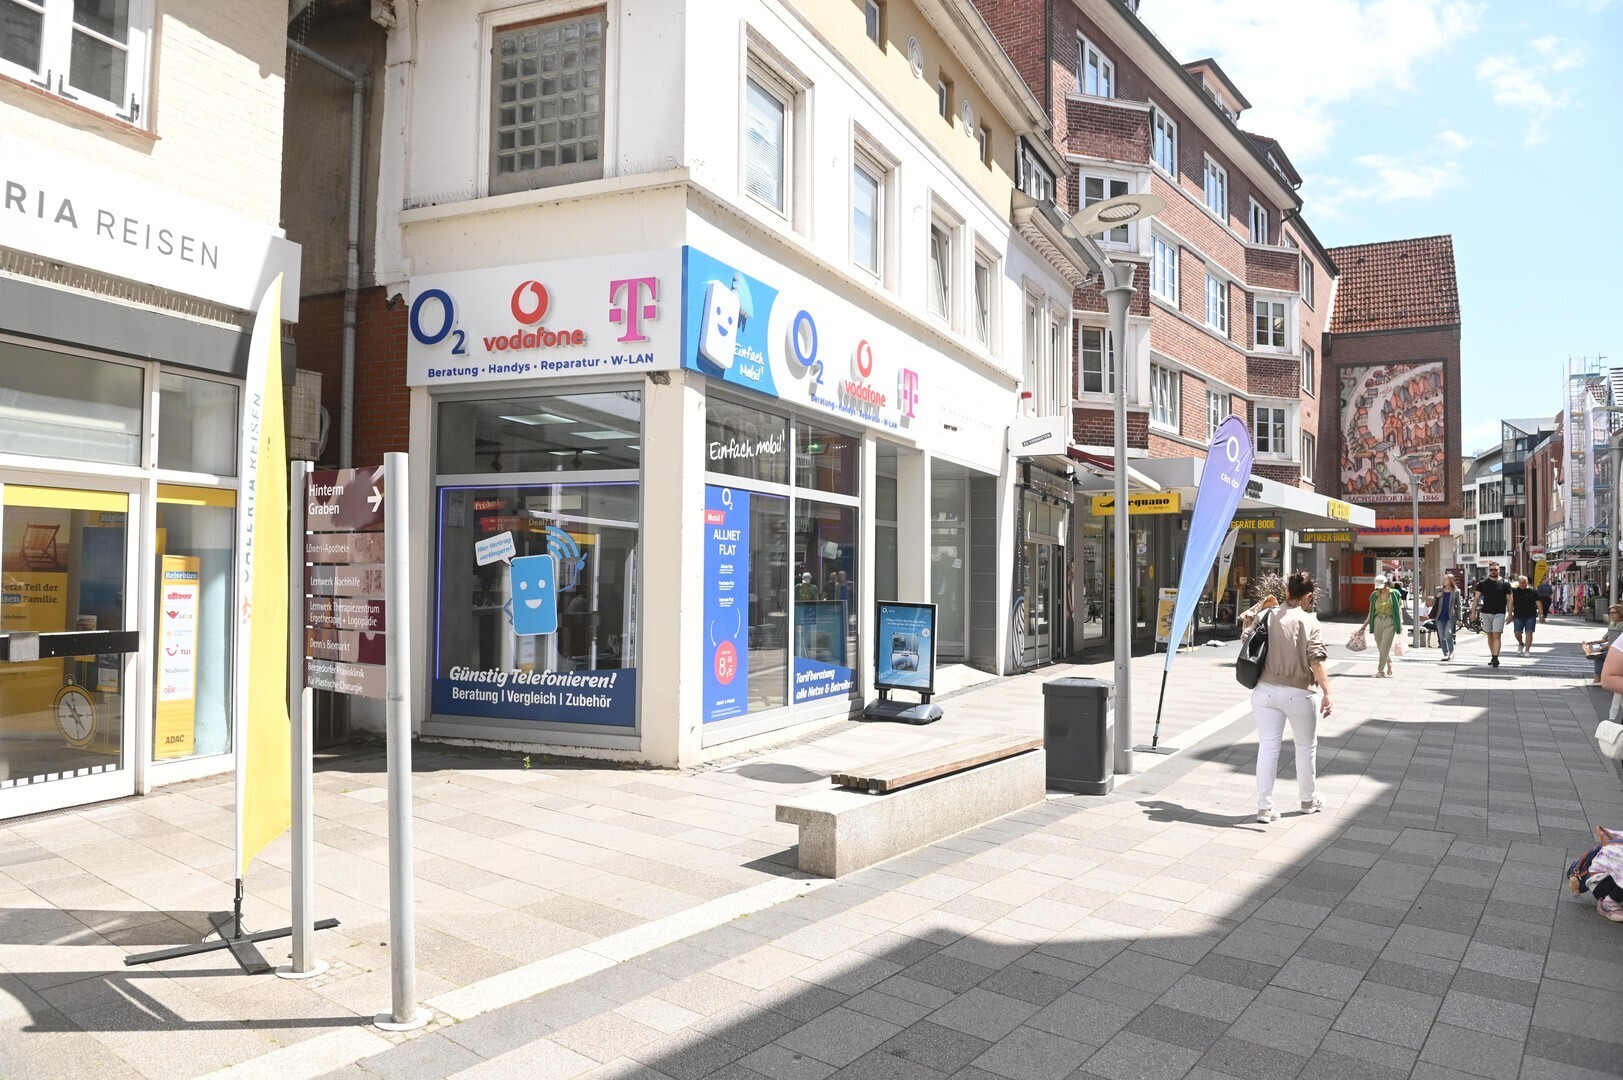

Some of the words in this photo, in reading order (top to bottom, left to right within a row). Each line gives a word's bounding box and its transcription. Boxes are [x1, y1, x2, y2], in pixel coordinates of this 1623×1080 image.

[5, 180, 78, 229] RIA
[96, 208, 218, 270] REISEN
[483, 327, 585, 352] vodafone
[733, 343, 765, 366] Einfach
[428, 366, 478, 378] Beratung
[488, 362, 530, 374] Handys
[541, 356, 600, 371] Reparatur
[611, 353, 654, 365] W-LAN
[845, 379, 886, 408] vodafone
[810, 393, 835, 411] Beratung
[710, 437, 754, 461] Einfach
[756, 429, 786, 456] mobil!
[1221, 473, 1231, 485] can
[1231, 478, 1240, 488] do
[309, 484, 344, 497] Hinterm
[308, 502, 340, 515] Graben
[1257, 519, 1275, 529] BODE
[1404, 525, 1450, 534] Begedorf
[713, 529, 741, 541] ALLNET
[1304, 533, 1332, 542] OPTIKER
[1333, 533, 1351, 542] BODE
[306, 543, 350, 555] Löwen-Apotheke
[489, 537, 512, 549] Vertrag
[719, 544, 736, 556] FLAT
[165, 571, 197, 580] Reisebüro
[310, 576, 334, 587] Lernwerk
[334, 577, 361, 587] Nachhilfe
[23, 595, 60, 603] Familie.
[167, 592, 192, 600] alltours
[310, 601, 332, 612] Lernwerk
[333, 602, 380, 615] Therapiezentrum
[310, 612, 341, 626] Ergotherapie
[347, 615, 377, 628] Logopädie
[310, 638, 326, 649] Denn's
[327, 640, 350, 652] Biomarkt
[308, 662, 336, 676] Bergedorfer
[337, 665, 365, 679] Praxisklinik
[449, 665, 508, 687] Günstig
[511, 669, 617, 689] Telefonieren!
[796, 669, 835, 684] Tarifberatung
[315, 677, 339, 690] Plastische
[339, 680, 363, 693] Chirurgie
[795, 689, 808, 700] alle
[808, 686, 824, 698] Netze
[825, 683, 830, 693] &
[452, 687, 498, 704] Beratung
[507, 690, 556, 707] Vergleich
[566, 693, 612, 708] Zubehör
[165, 735, 185, 744] ADAC
